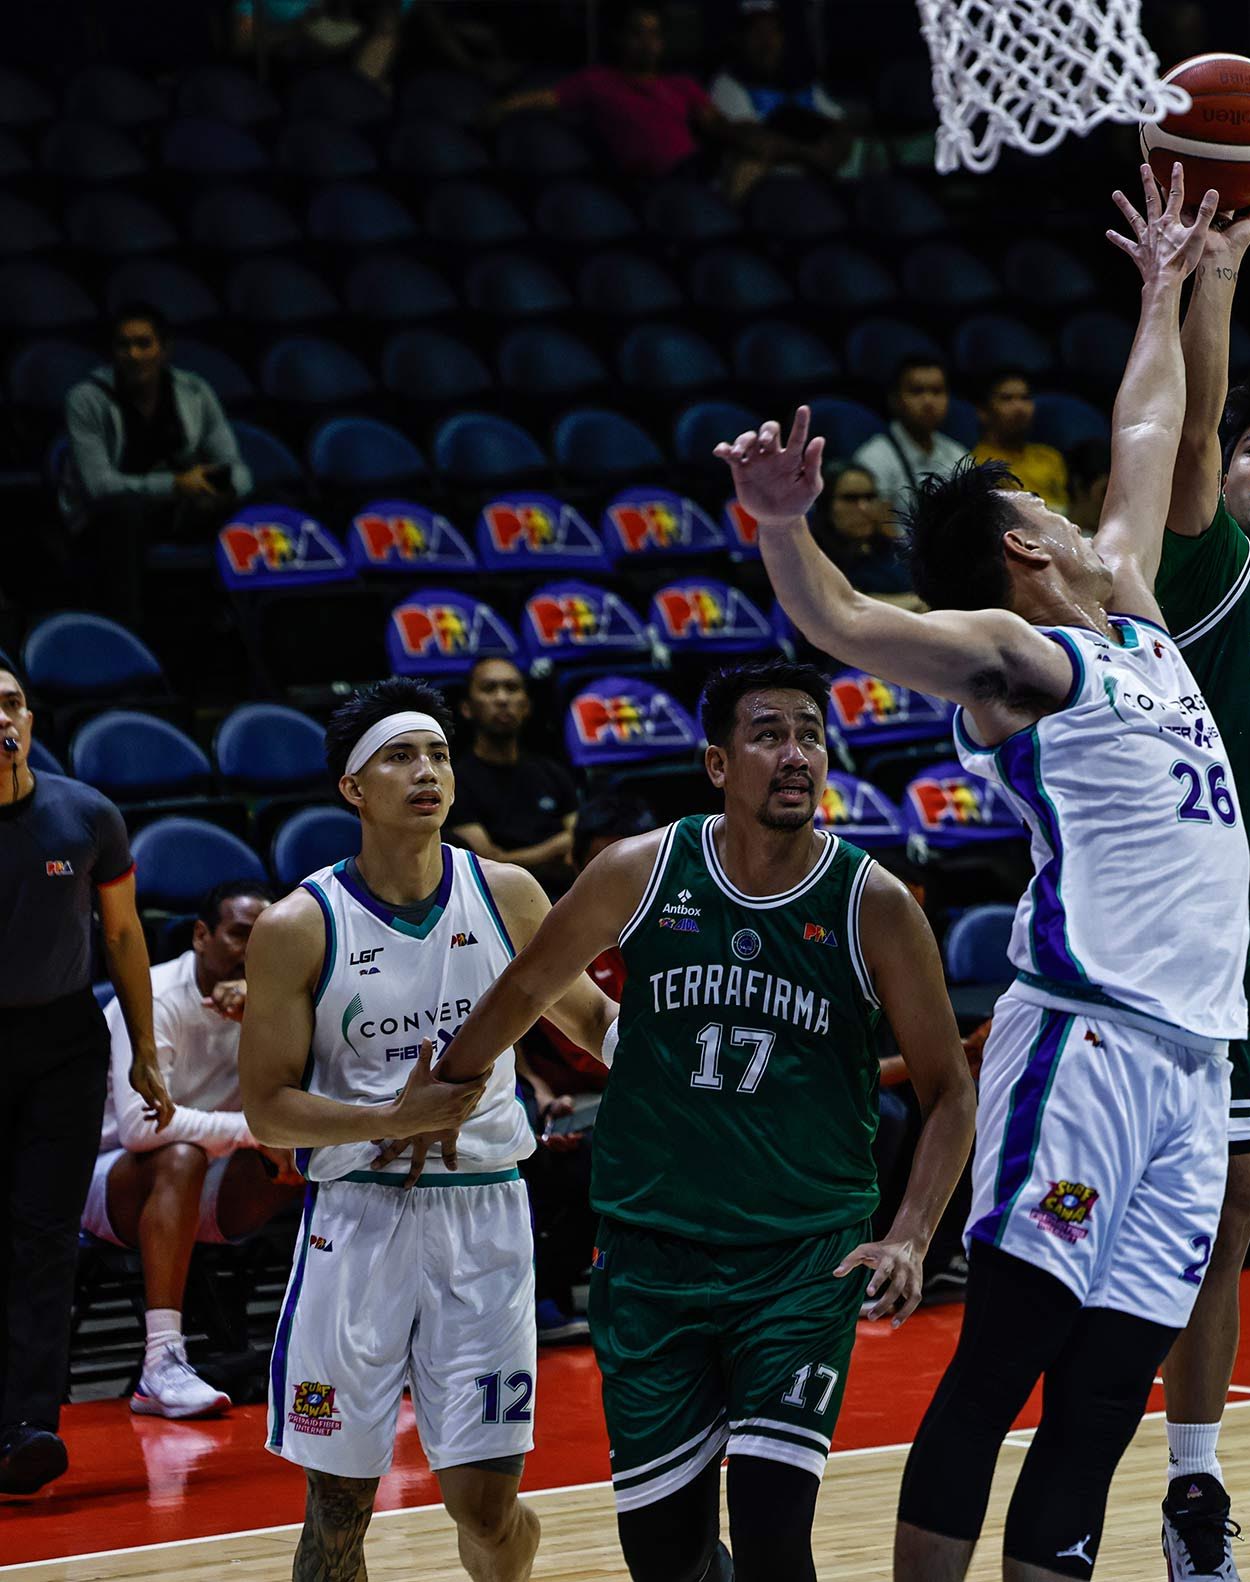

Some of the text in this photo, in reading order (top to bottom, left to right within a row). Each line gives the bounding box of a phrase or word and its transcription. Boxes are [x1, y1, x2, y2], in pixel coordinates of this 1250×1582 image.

[1169, 759, 1236, 828] 26
[662, 903, 701, 917] Antbox
[450, 931, 478, 949] PBA
[650, 965, 830, 1035] TERRAFIRMA
[690, 1022, 776, 1093] 17
[299, 1381, 332, 1397] SURF
[475, 1370, 533, 1424] 12
[781, 1362, 839, 1415] 17
[310, 1394, 319, 1403] 2
[294, 1399, 332, 1417] SAWA
[288, 1414, 340, 1429] PREPAID FIBER
[295, 1423, 331, 1435] INTERNET
